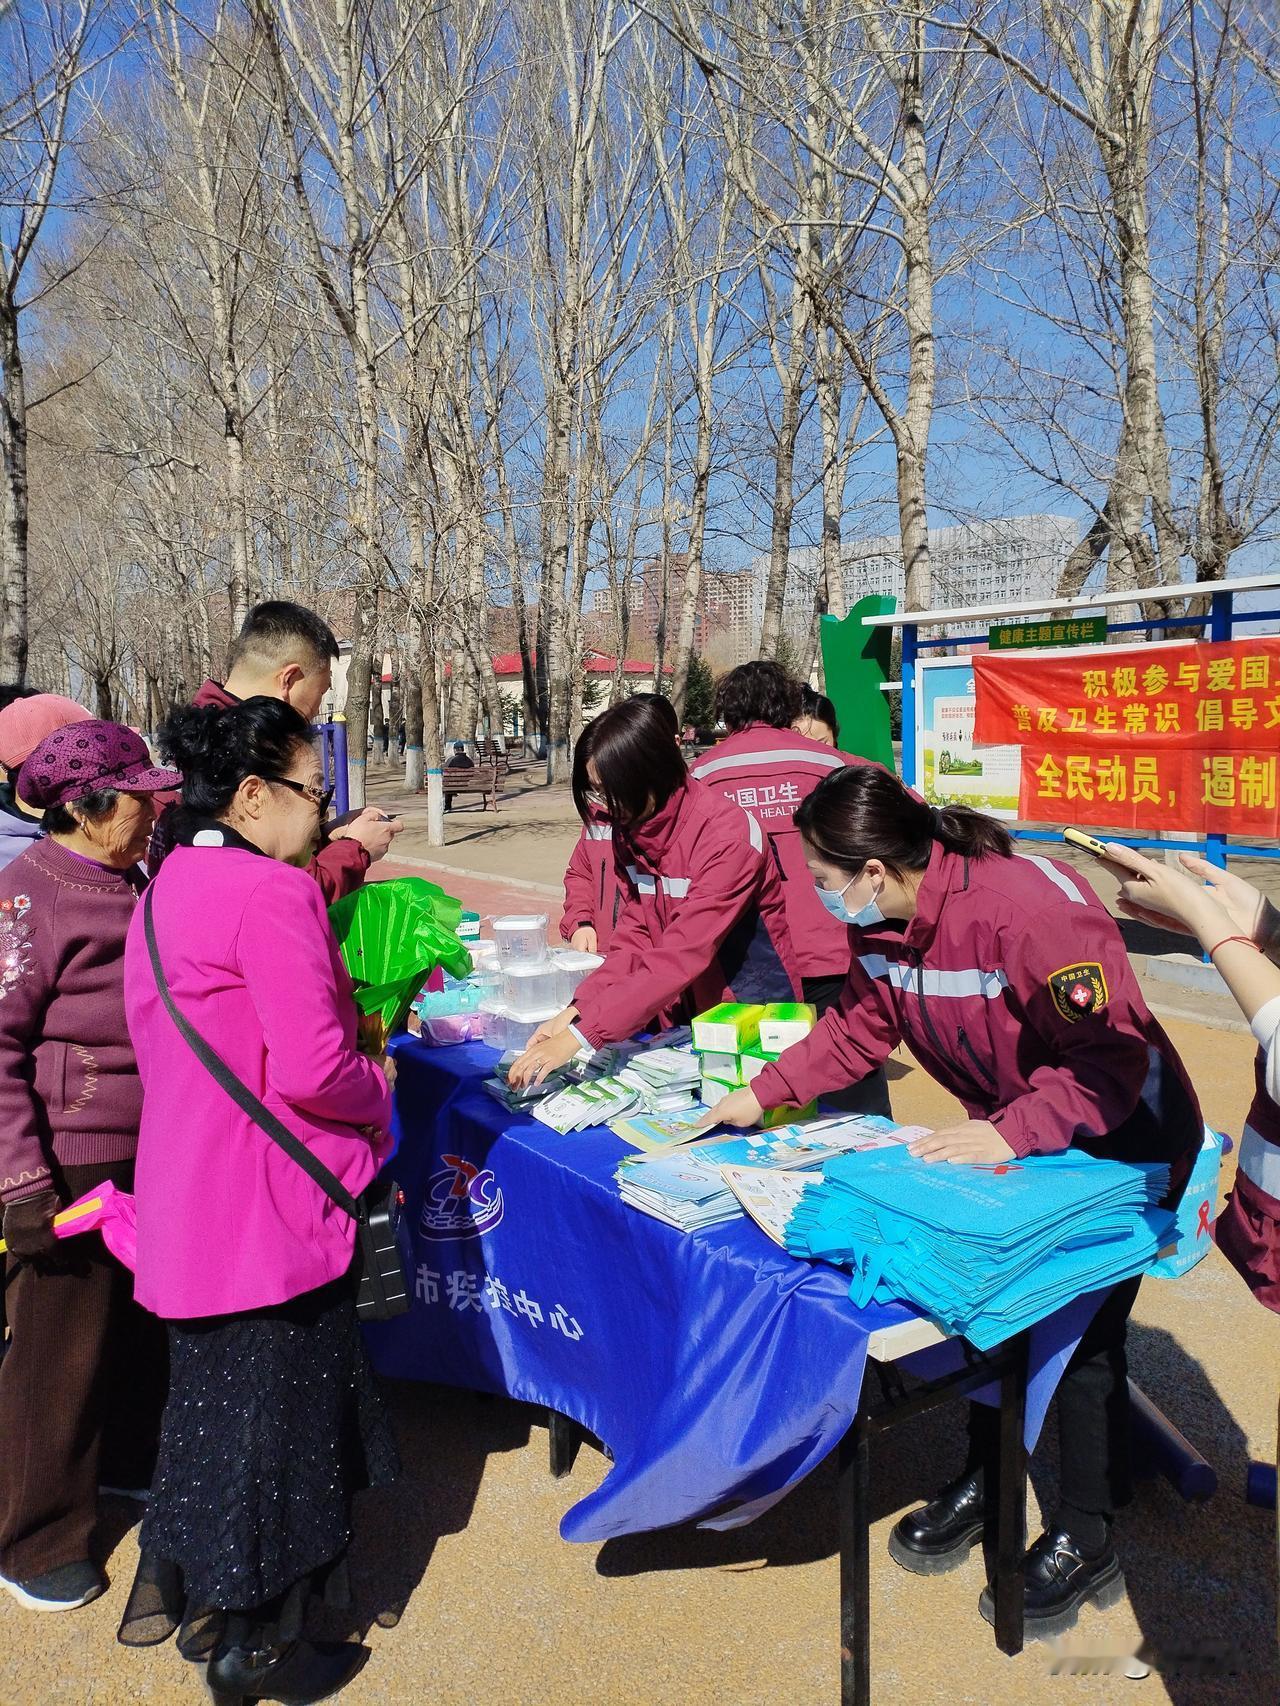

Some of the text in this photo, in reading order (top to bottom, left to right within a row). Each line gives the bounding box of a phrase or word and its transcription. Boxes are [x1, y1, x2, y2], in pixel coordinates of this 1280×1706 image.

[1000, 622, 1094, 644] 健康主题宣传栏
[1082, 655, 1280, 699] 积极参与爱国
[1012, 702, 1181, 735] 普及卫生常识
[760, 805, 799, 819] HEALT
[415, 1263, 584, 1341] 市疾控中心
